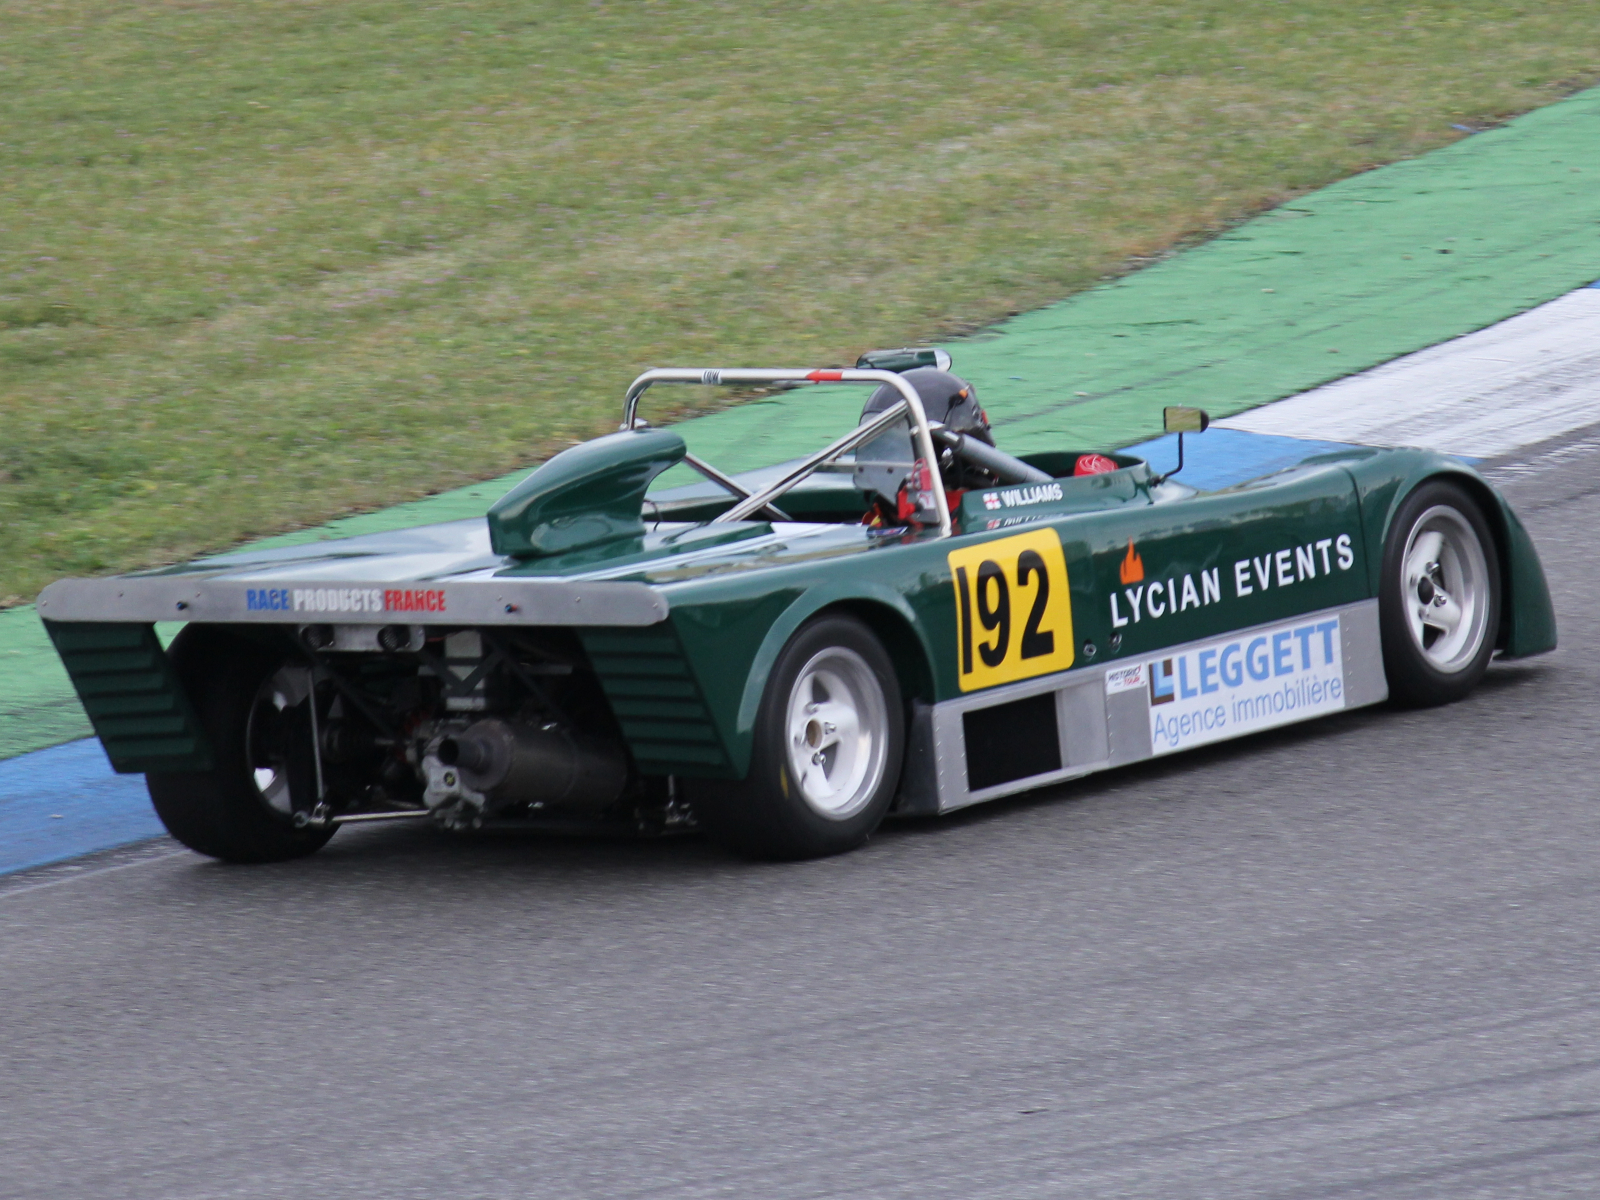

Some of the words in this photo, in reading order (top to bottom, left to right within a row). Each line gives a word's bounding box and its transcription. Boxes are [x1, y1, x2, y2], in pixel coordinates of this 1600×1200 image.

[1000, 483, 1063, 508] WILLIAMS
[246, 588, 290, 611] RACE
[293, 588, 382, 612] PRODUCTS
[384, 589, 447, 612] FRANCE
[955, 549, 1055, 674] 192
[1110, 567, 1221, 628] LYCIAN
[1234, 534, 1354, 597] EVENTS
[1178, 619, 1338, 700] LEGGETT
[1153, 705, 1226, 747] Agence
[1232, 675, 1341, 723] immobilière
